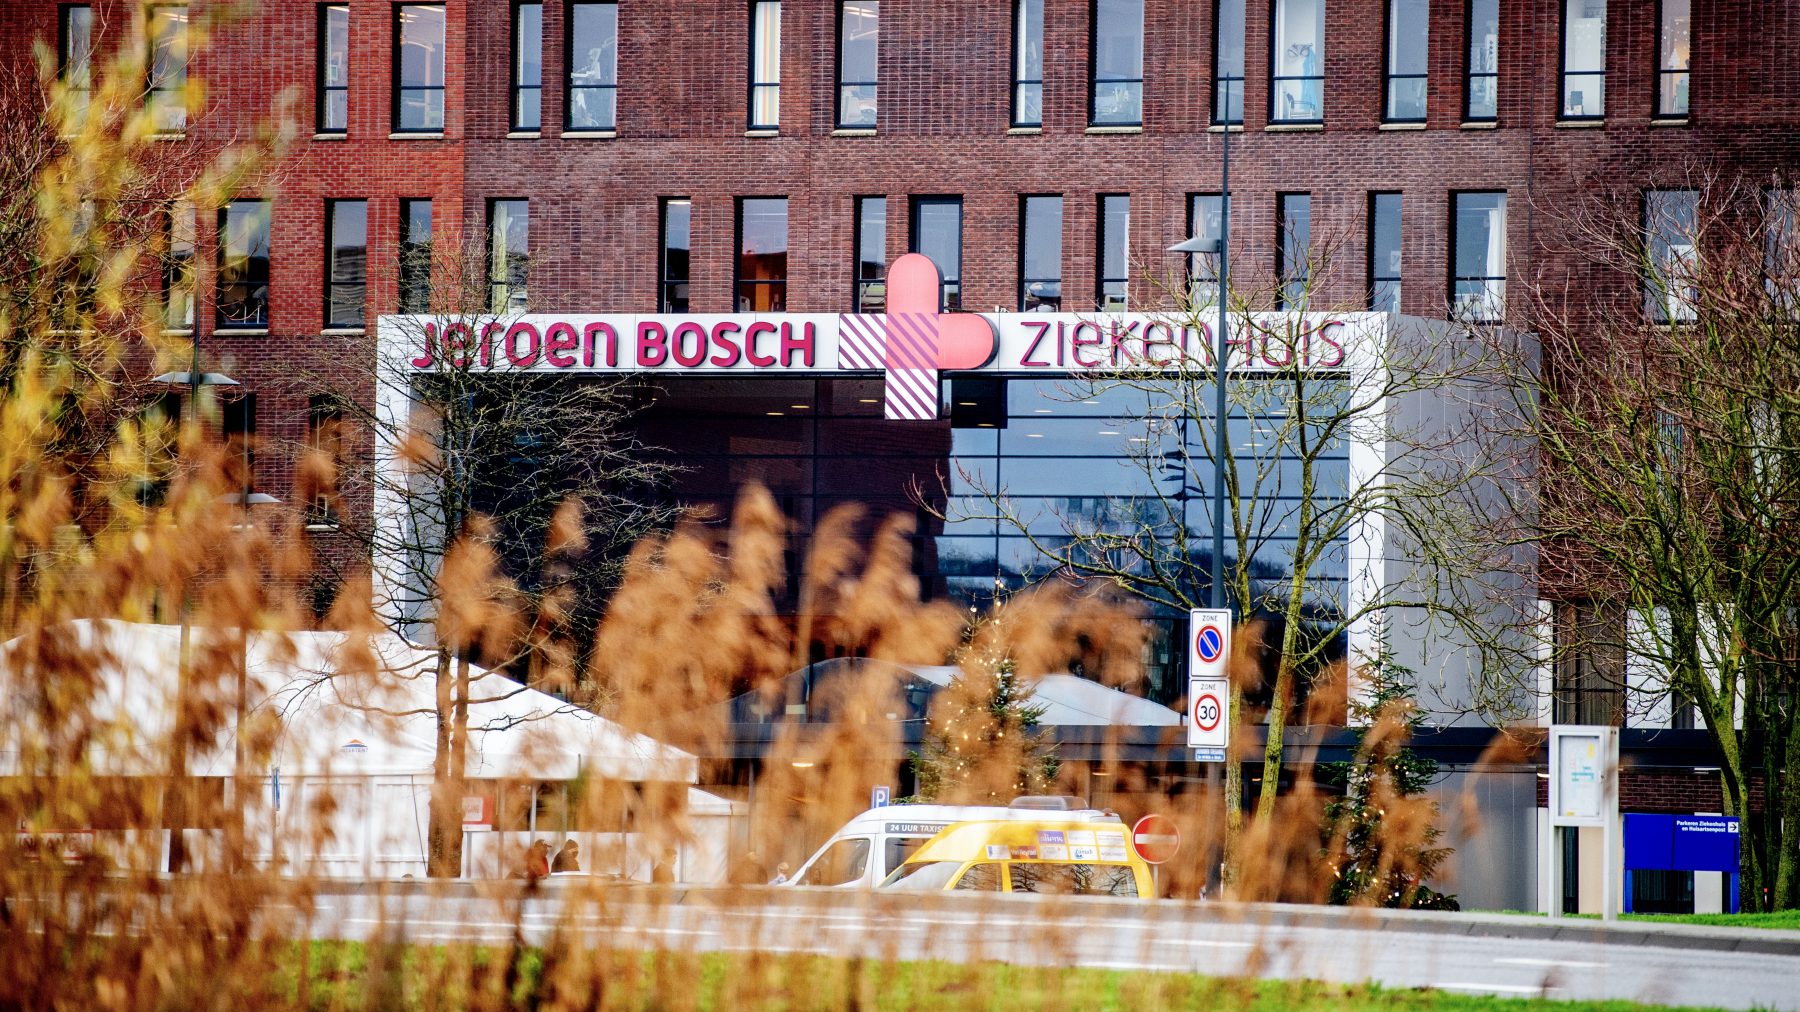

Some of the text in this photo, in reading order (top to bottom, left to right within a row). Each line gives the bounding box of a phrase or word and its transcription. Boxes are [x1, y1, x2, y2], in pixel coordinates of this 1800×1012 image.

[636, 320, 816, 368] BOSCH
[1202, 614, 1218, 622] ZONE
[1200, 683, 1216, 691] ZONE
[1199, 705, 1218, 720] 30
[876, 789, 886, 808] P
[890, 824, 900, 832] 24
[901, 824, 918, 832] UUR
